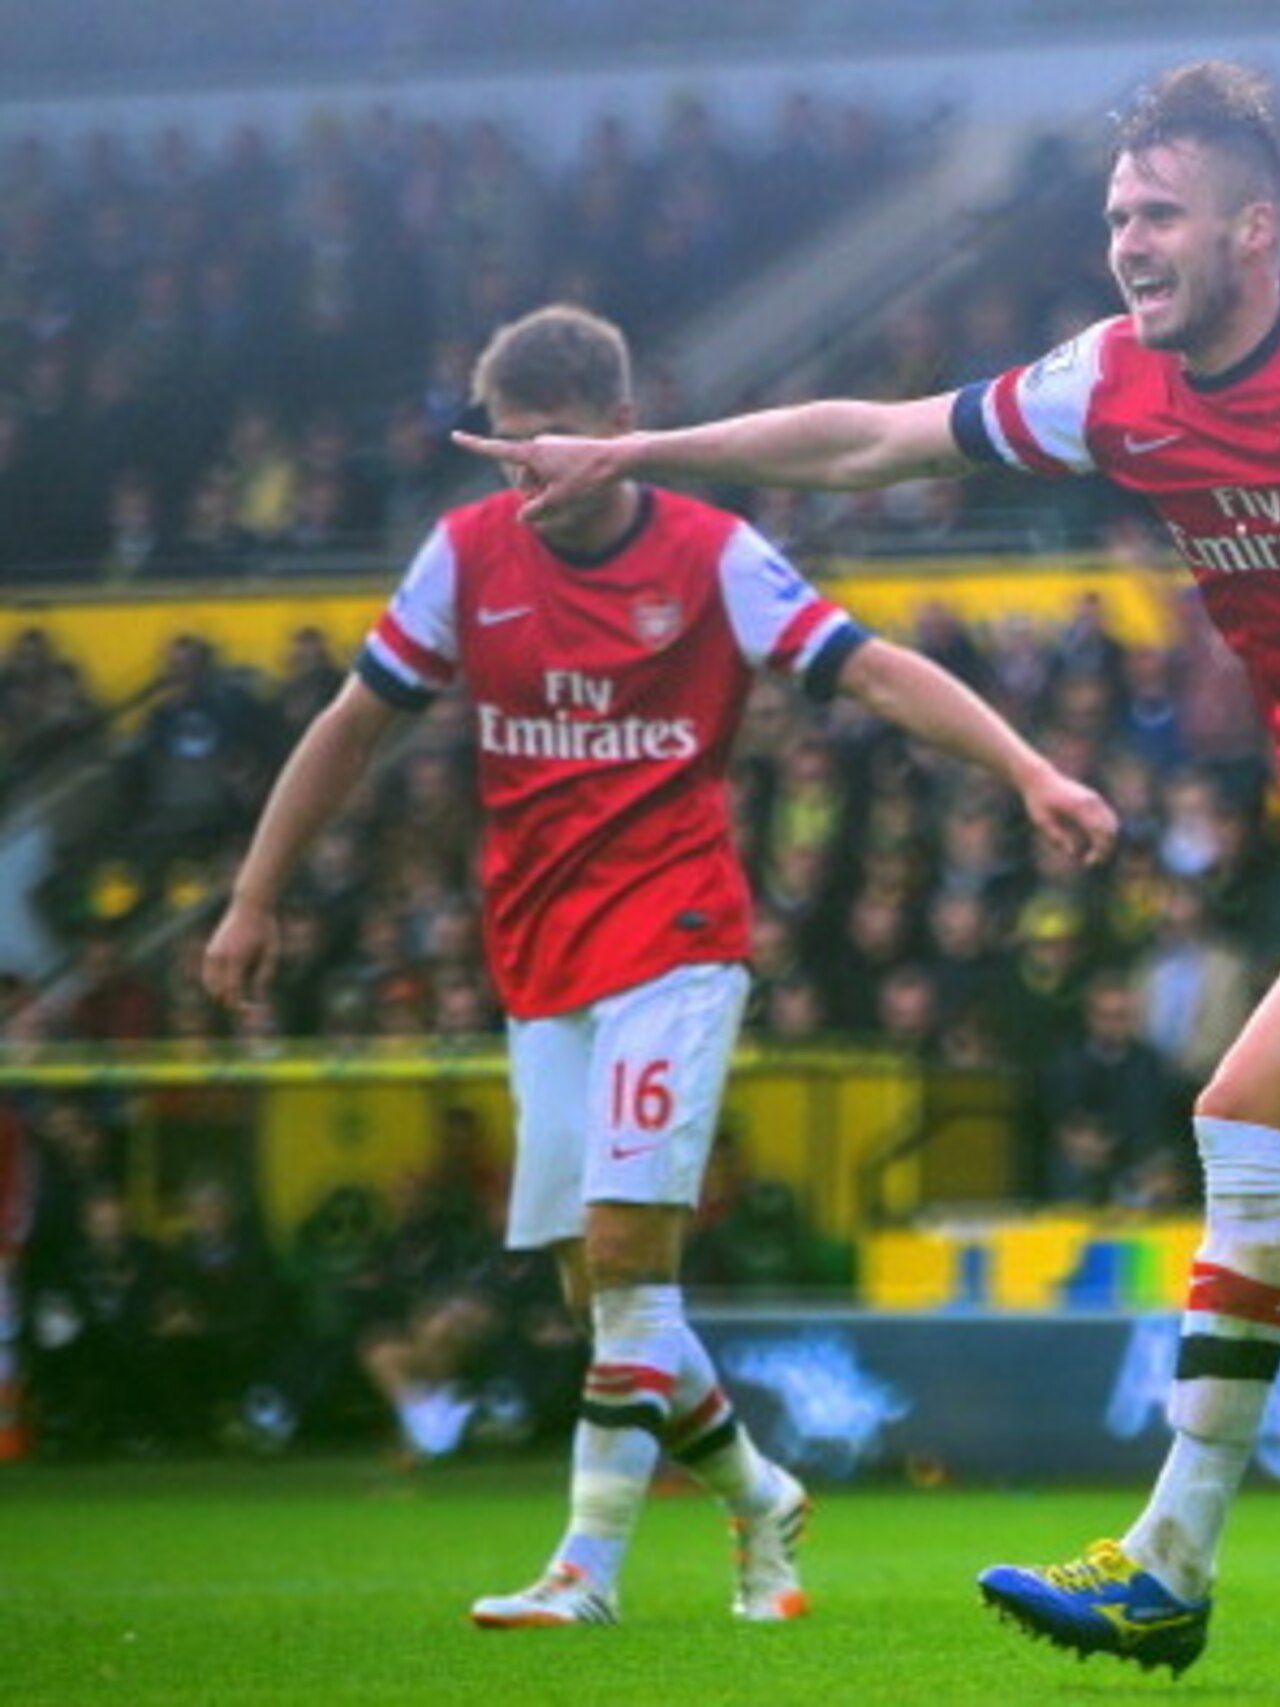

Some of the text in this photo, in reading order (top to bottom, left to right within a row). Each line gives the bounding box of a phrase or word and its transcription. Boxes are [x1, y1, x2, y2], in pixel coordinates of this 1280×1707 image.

[544, 668, 614, 715] Fly
[477, 703, 698, 761] Emirates
[611, 1059, 674, 1131] 16
